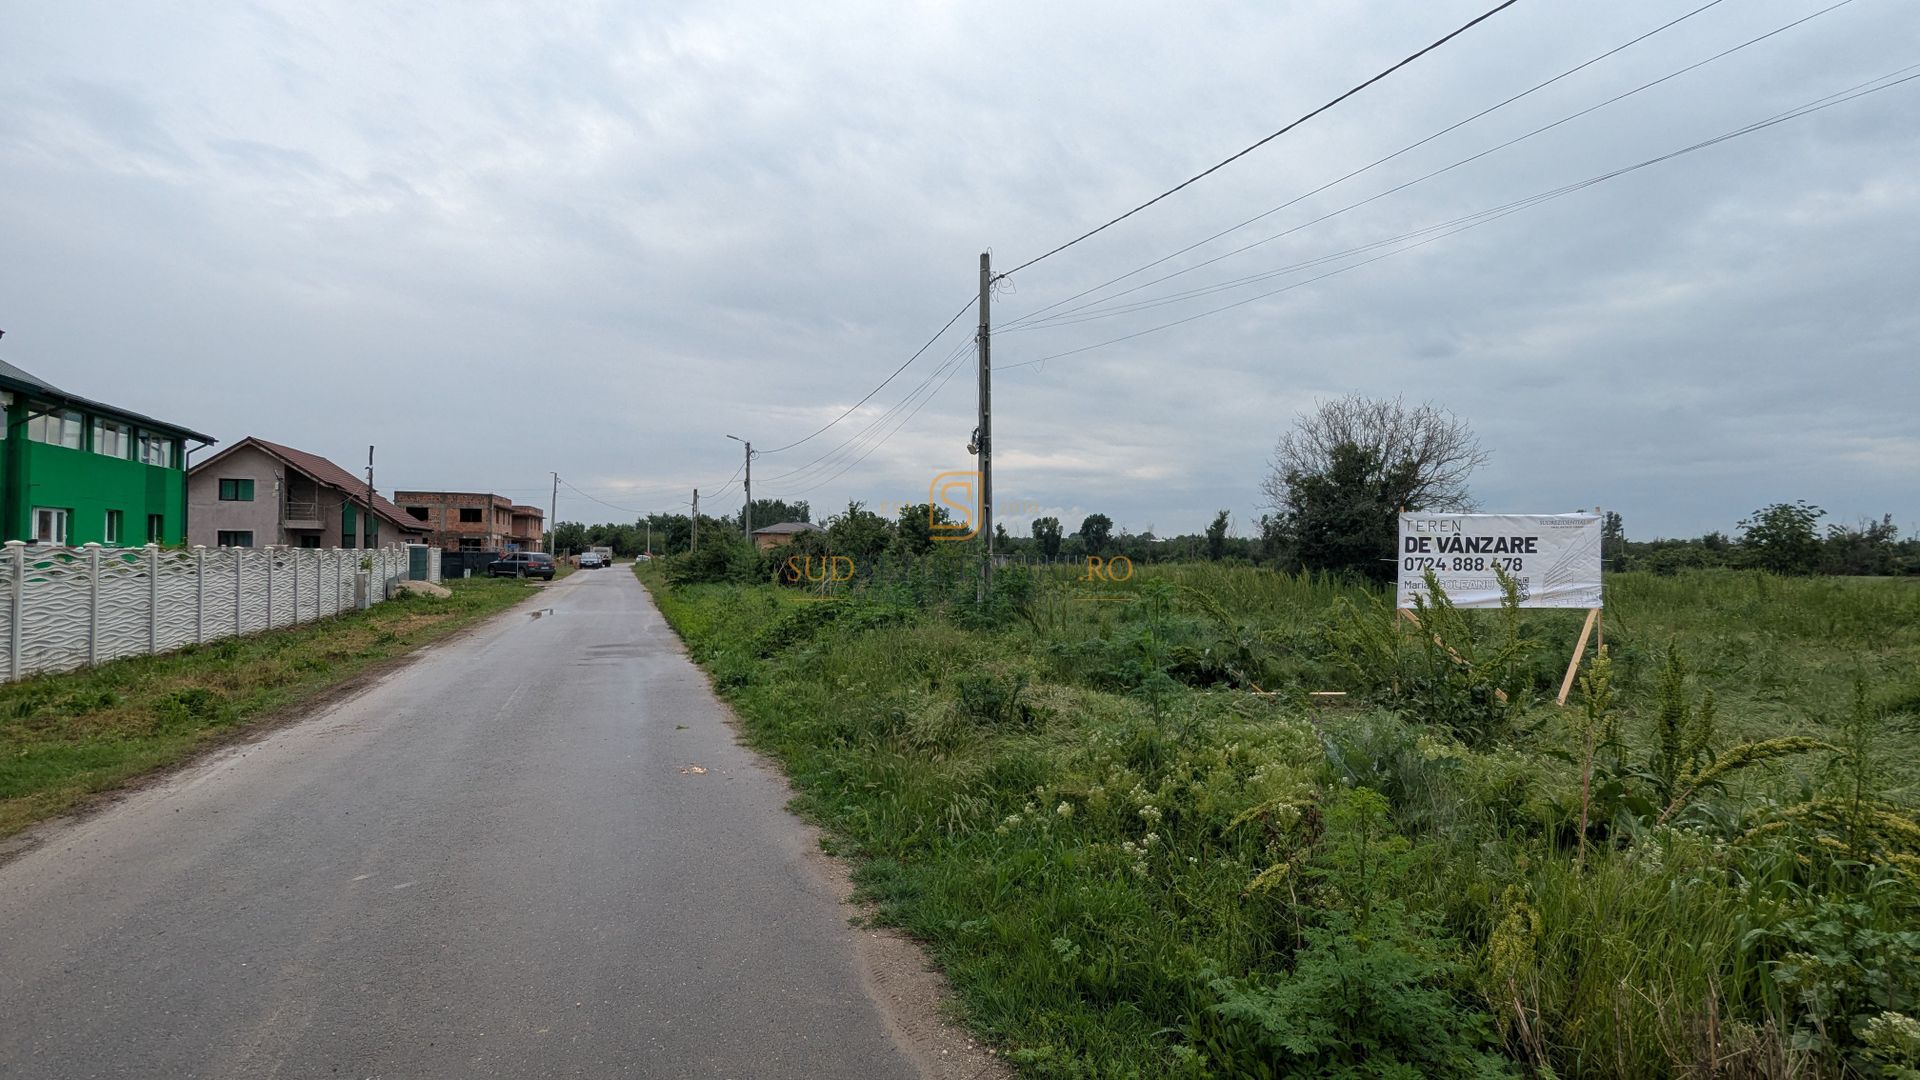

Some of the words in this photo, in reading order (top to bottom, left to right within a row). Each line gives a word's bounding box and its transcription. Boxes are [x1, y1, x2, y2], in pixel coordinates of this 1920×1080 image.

[1406, 519, 1461, 532] TEREN
[1405, 537, 1431, 553] DE
[1436, 533, 1539, 553] VÂNZARE
